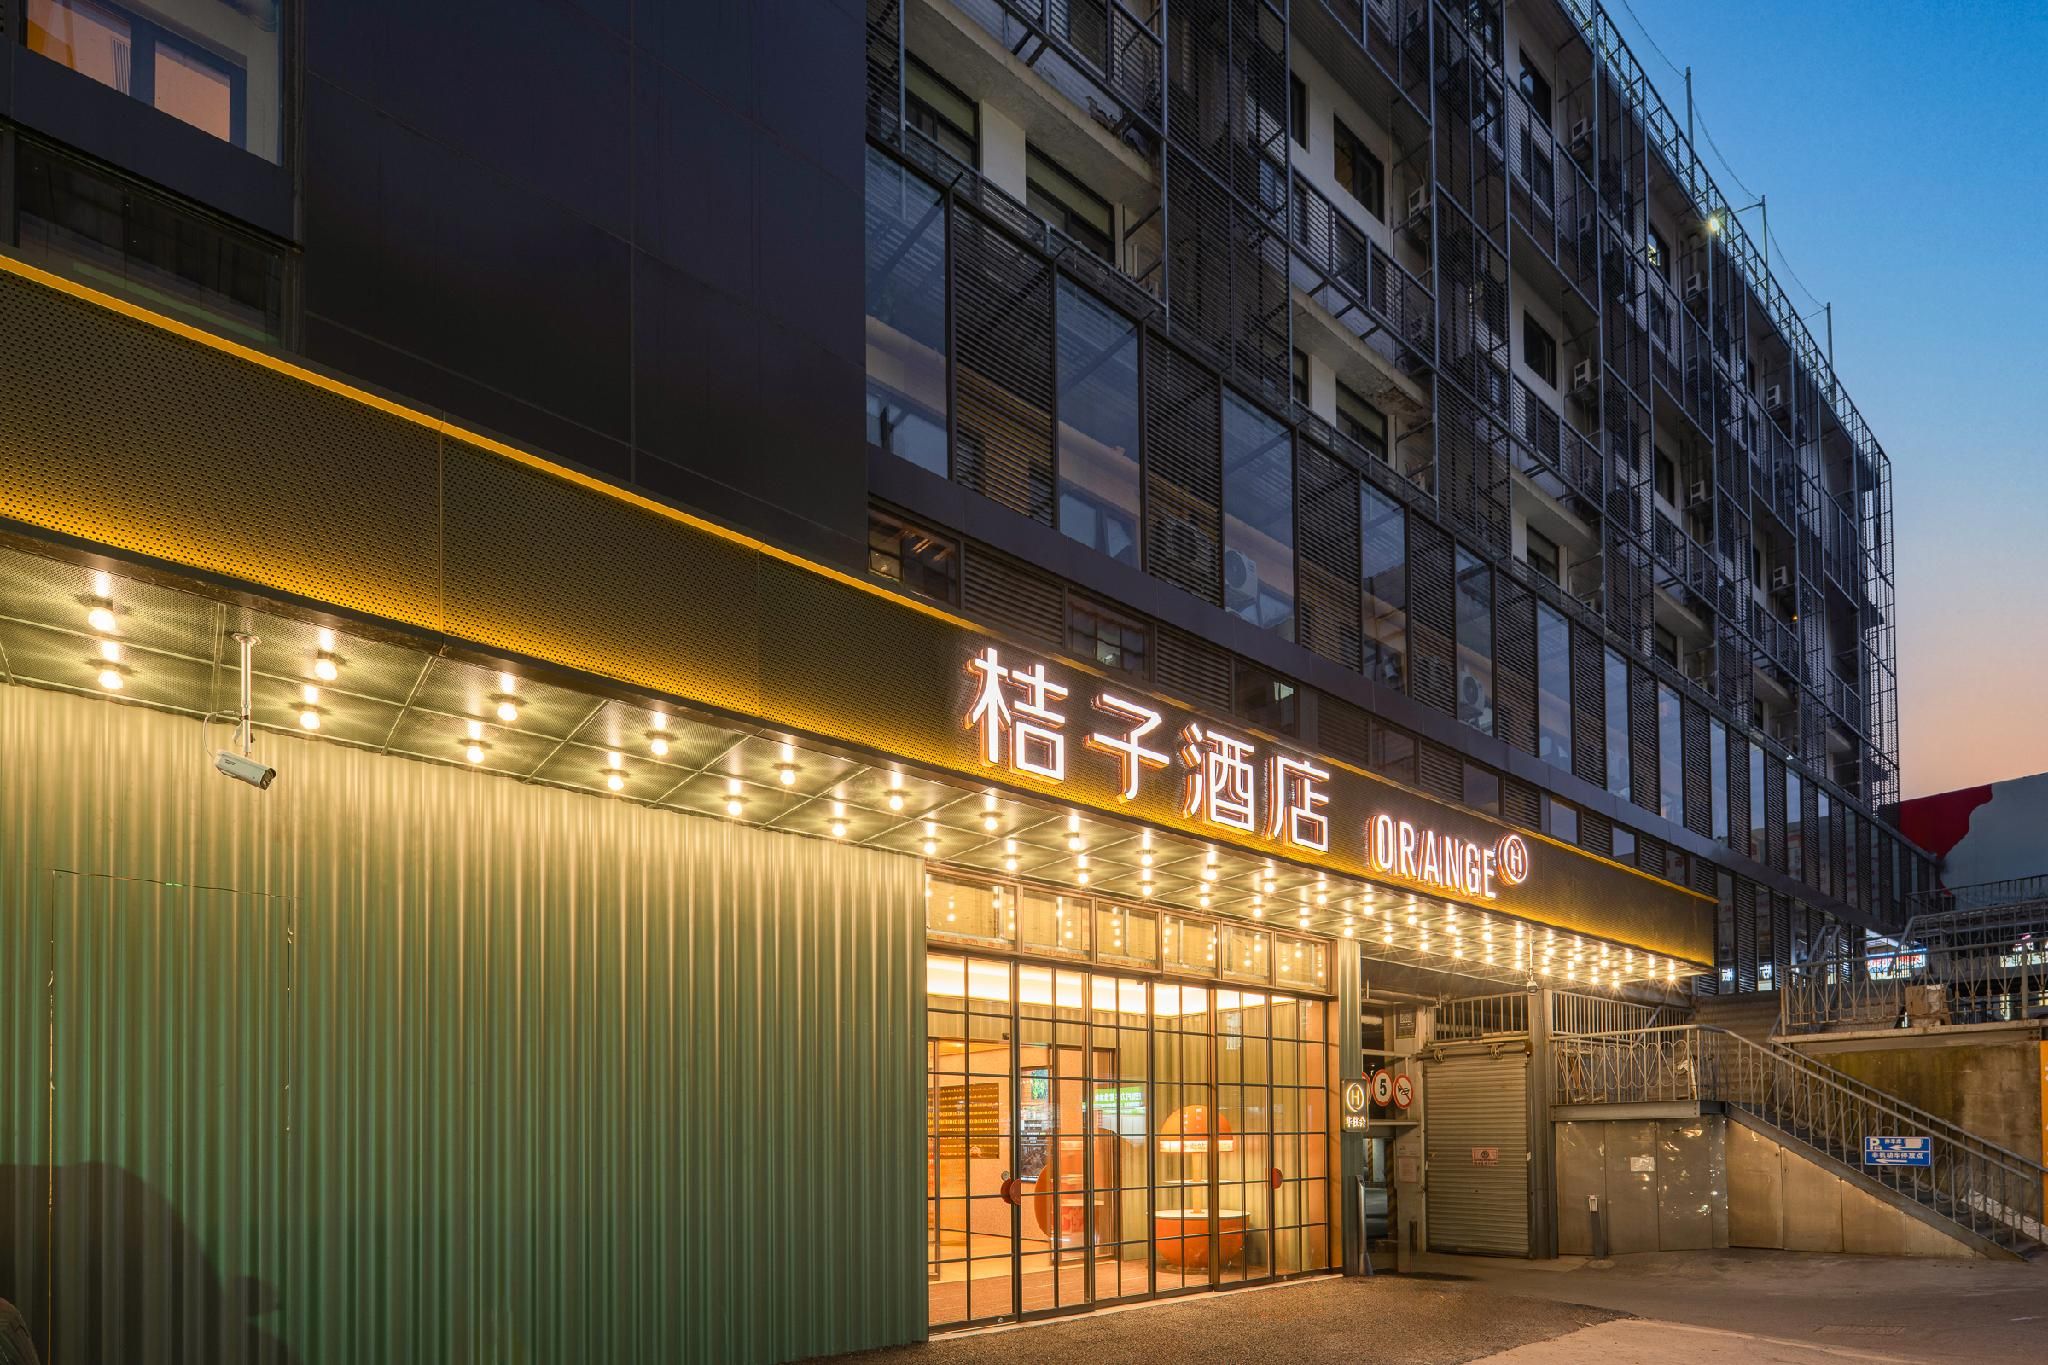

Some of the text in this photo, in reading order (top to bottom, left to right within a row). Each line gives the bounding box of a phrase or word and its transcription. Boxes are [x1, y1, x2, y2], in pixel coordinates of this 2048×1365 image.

[964, 647, 1330, 853] 桔子酒店
[1370, 813, 1496, 899] ORANGE
[1380, 1079, 1387, 1096] 5
[1869, 1138, 1880, 1150] P
